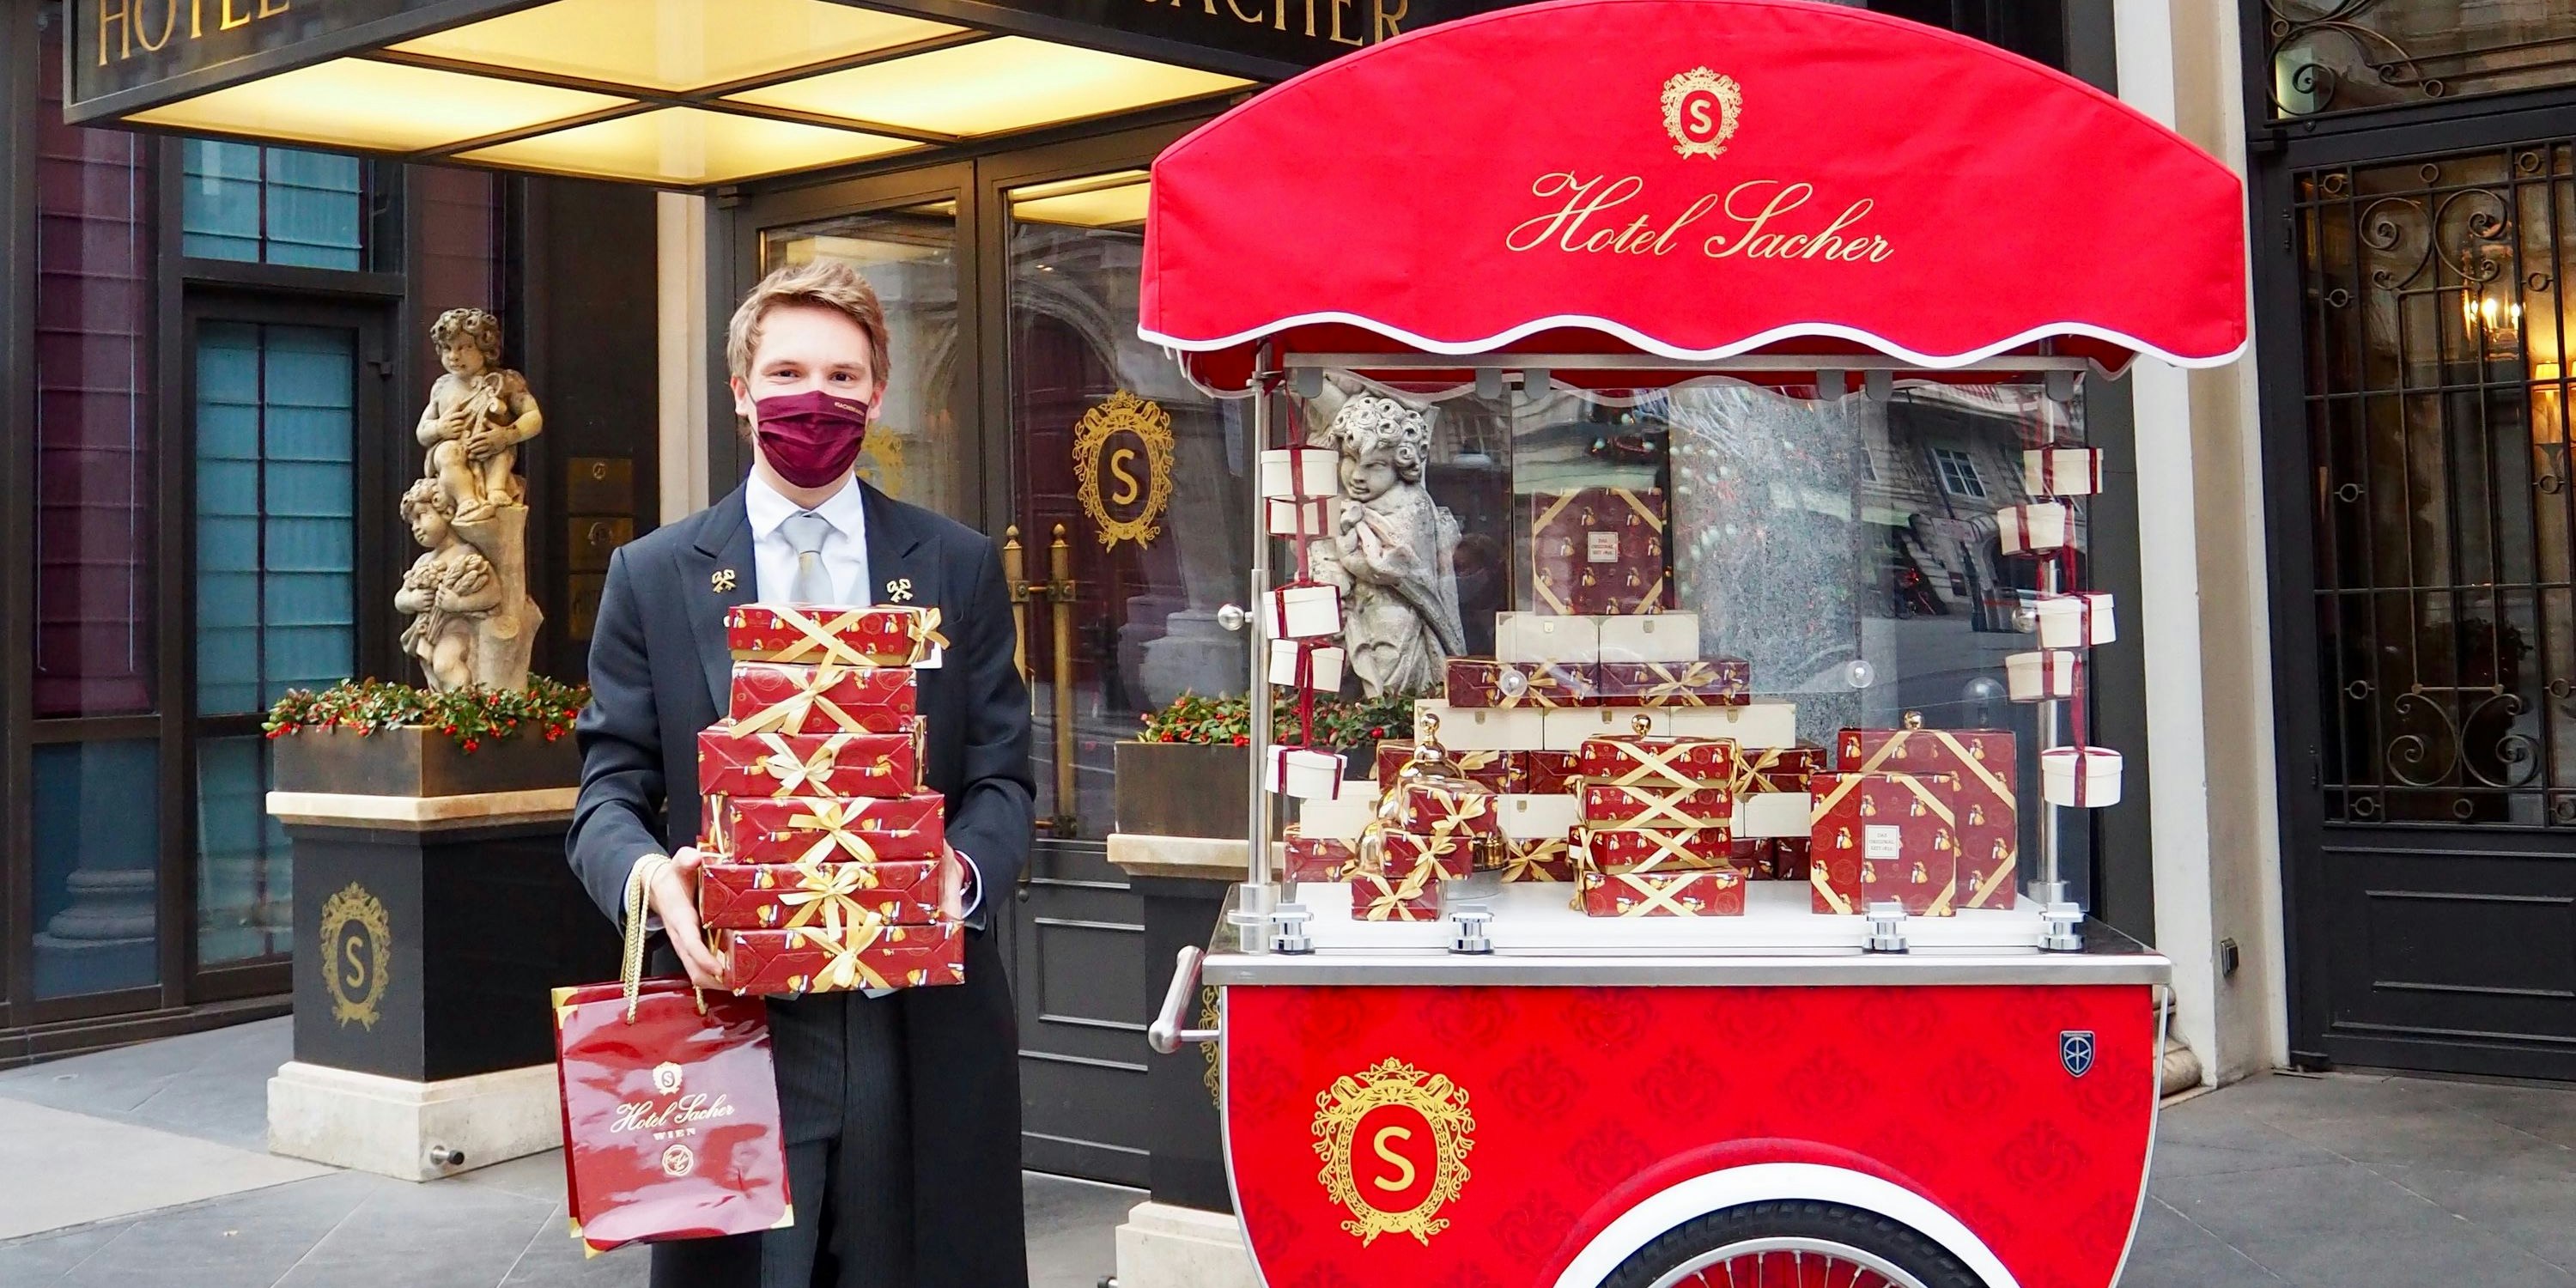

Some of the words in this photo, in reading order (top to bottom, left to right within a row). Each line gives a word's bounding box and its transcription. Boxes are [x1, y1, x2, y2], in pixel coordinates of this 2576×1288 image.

[1689, 99, 1711, 134] S
[1505, 170, 1718, 255] Hotel
[1703, 179, 1894, 263] Sacher
[1111, 448, 1138, 505] S
[345, 936, 365, 987] S
[610, 1100, 678, 1133] Hotel
[673, 1093, 735, 1124] Sacher
[653, 1127, 696, 1140] WIEN
[1374, 1126, 1415, 1191] S
